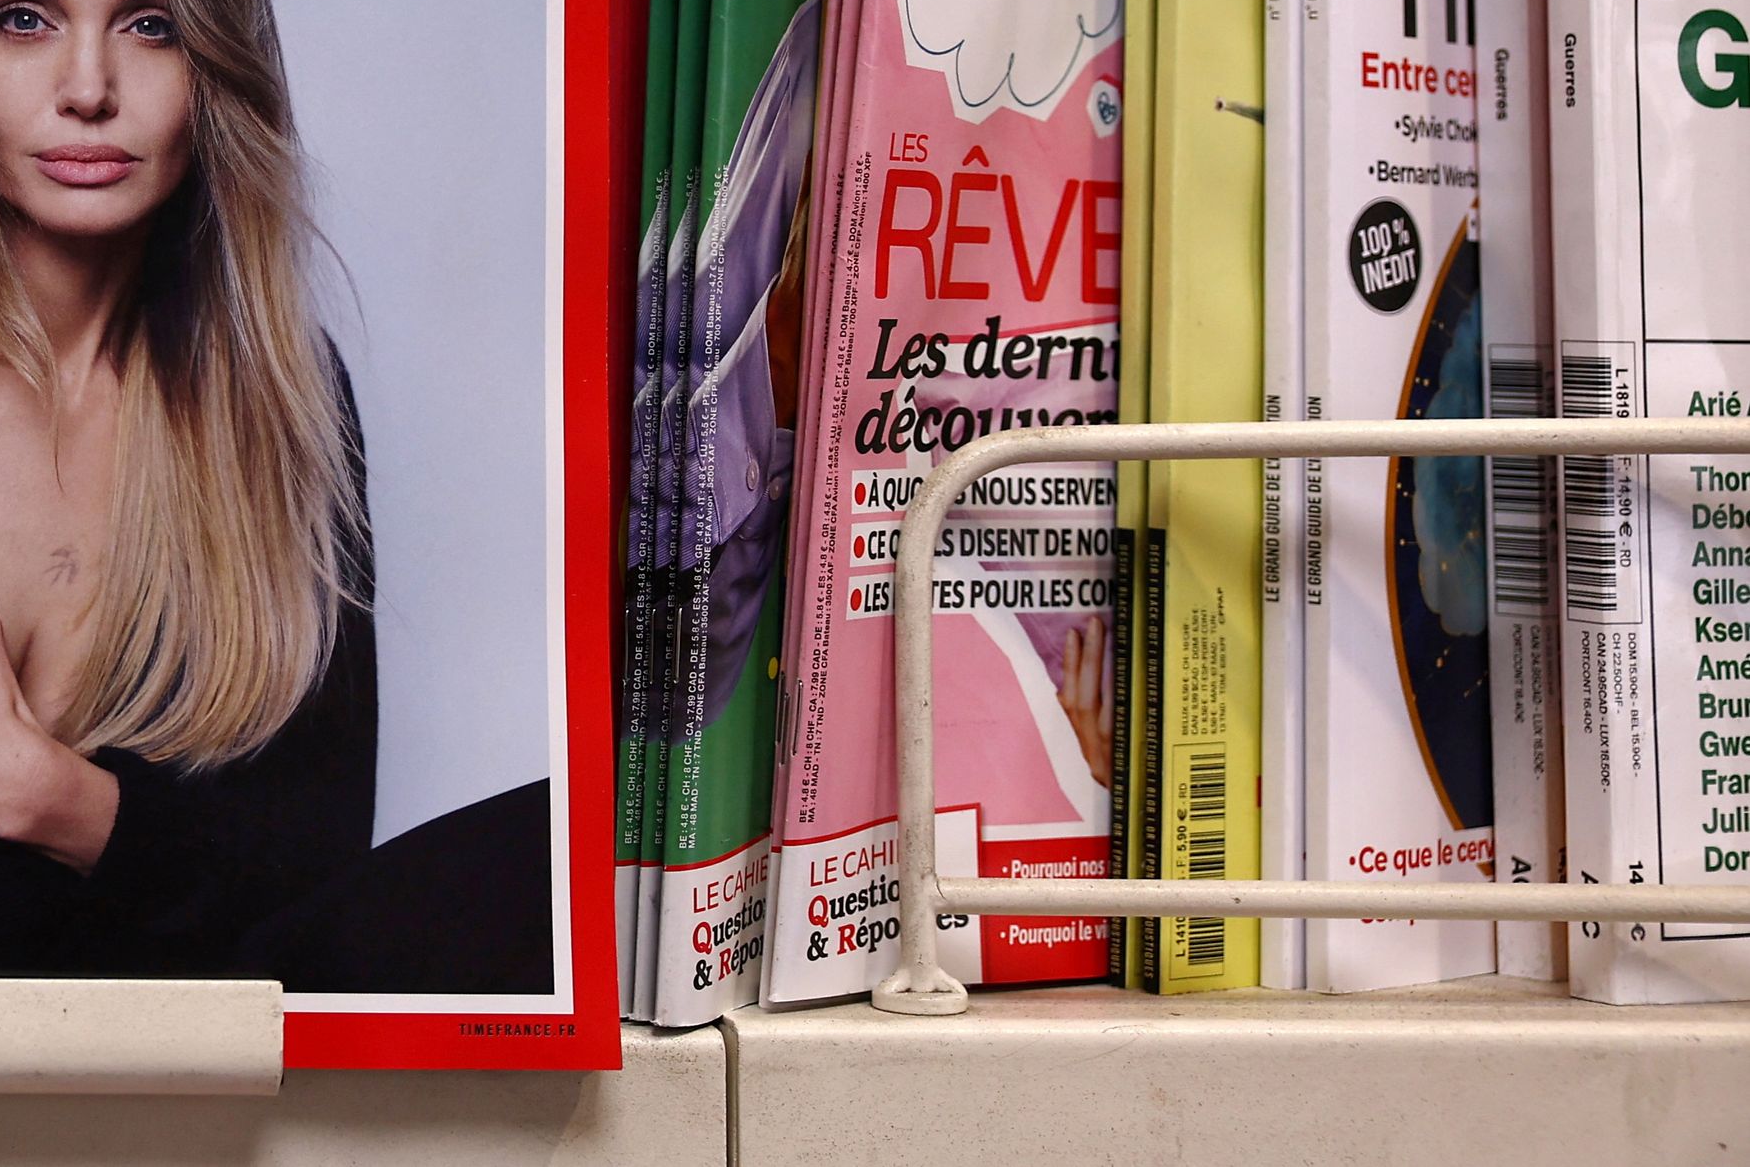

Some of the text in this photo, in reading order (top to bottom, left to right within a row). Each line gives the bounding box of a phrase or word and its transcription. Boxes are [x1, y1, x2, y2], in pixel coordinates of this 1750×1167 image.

[1361, 51, 1438, 95] Entre
[1563, 32, 1577, 109] Guerres
[1401, 114, 1444, 143] Sylvie
[888, 131, 929, 163] LES
[1376, 159, 1441, 187] Bernard
[1360, 246, 1417, 295] INÉDIT
[866, 318, 950, 381] Les
[1687, 390, 1742, 417] Arié
[971, 476, 1037, 506] NOUS
[959, 528, 1072, 558] DISENT DE
[1307, 475, 1323, 606] LE GRAND GUIDE DE
[970, 578, 1074, 609] POUR LES
[810, 855, 838, 889] LE
[1010, 857, 1107, 880] Pourquoi nos
[1358, 837, 1454, 876] Ce que le
[806, 931, 830, 963] &
[1008, 920, 1095, 949] Pourquoi le
[458, 1022, 577, 1039] TIMEFRANCE.FR
